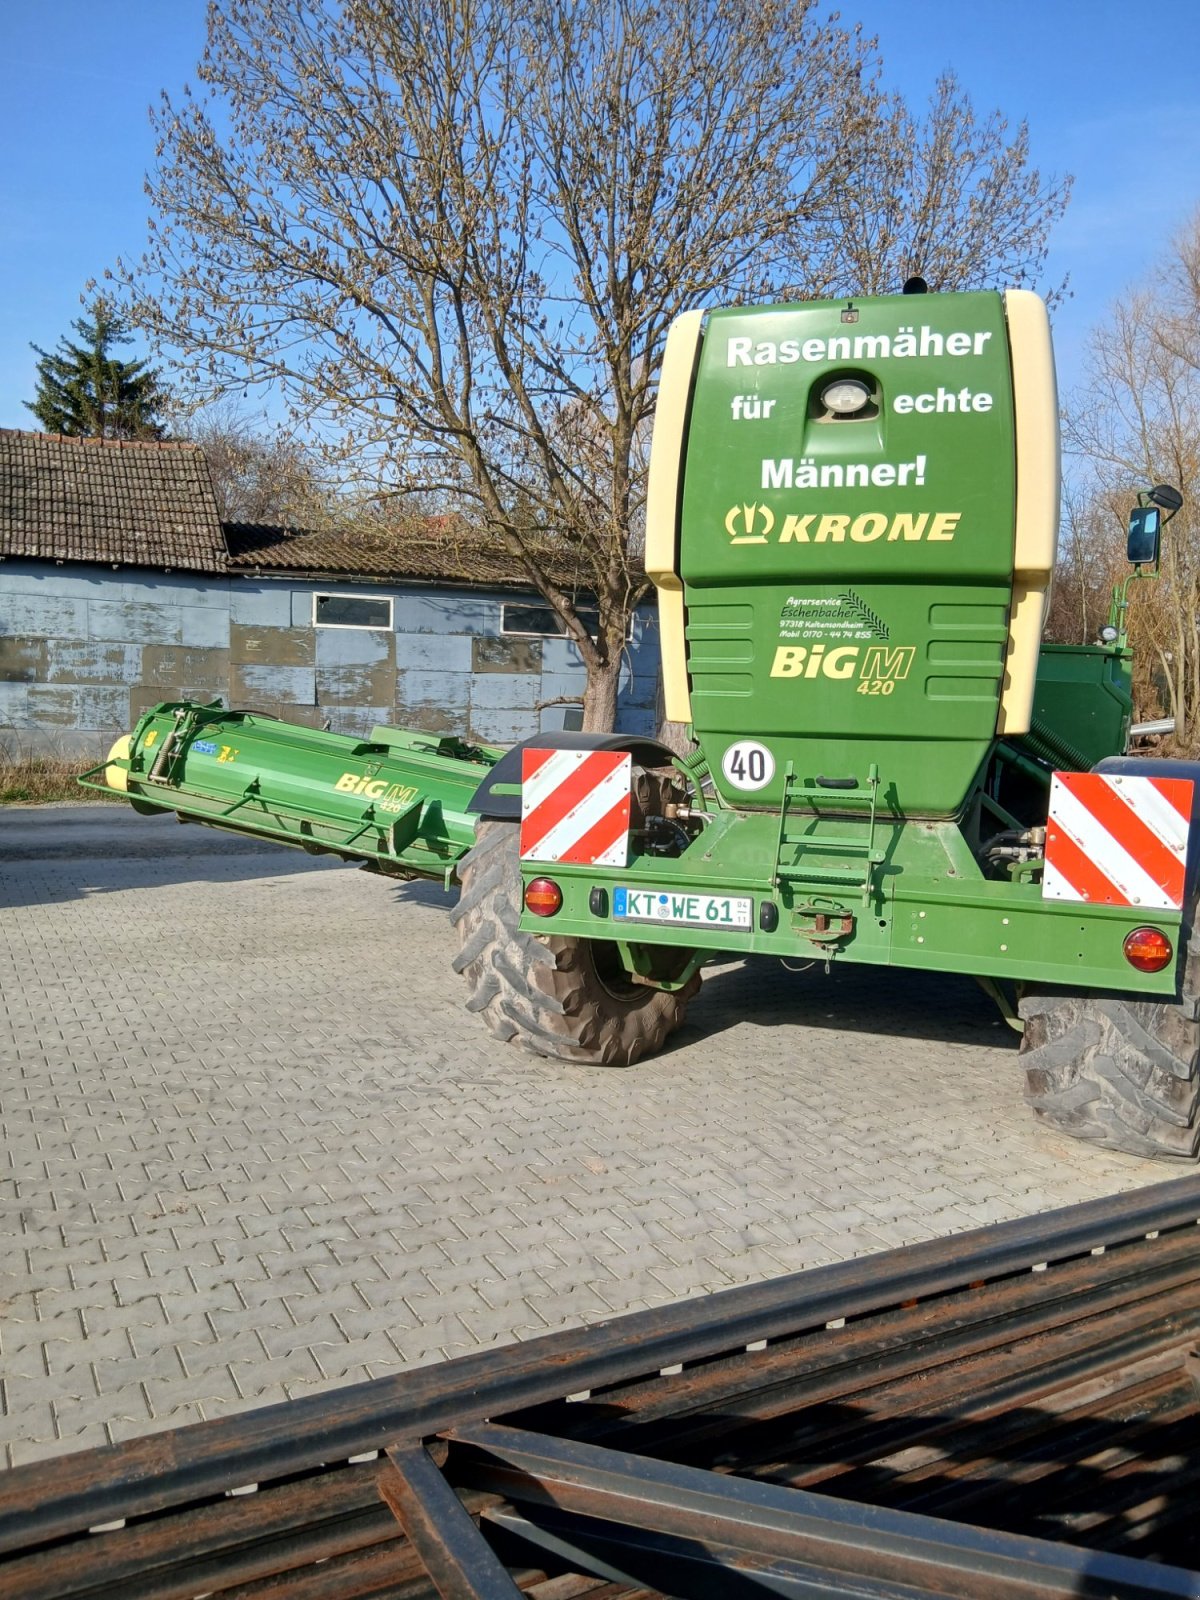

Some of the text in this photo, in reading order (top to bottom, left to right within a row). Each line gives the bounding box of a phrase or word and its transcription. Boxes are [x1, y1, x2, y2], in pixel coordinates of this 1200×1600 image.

[727, 326, 992, 367] Rasenmäher
[731, 387, 993, 420] für echte
[761, 455, 927, 489] Männer!
[778, 512, 962, 543] KRONE
[780, 606, 859, 618] Eschenbacher
[786, 596, 842, 607] Agrarservice
[779, 620, 864, 629] 97318 Kaltensondheim
[779, 630, 800, 638] Mobil
[854, 631, 872, 639] 855
[770, 644, 860, 680] BiG
[856, 680, 895, 695] 420
[730, 749, 765, 782] 40
[334, 772, 389, 799] BiG
[380, 801, 401, 813] 420
[627, 893, 656, 915] KT
[671, 896, 700, 919] WE
[705, 900, 733, 922] 61
